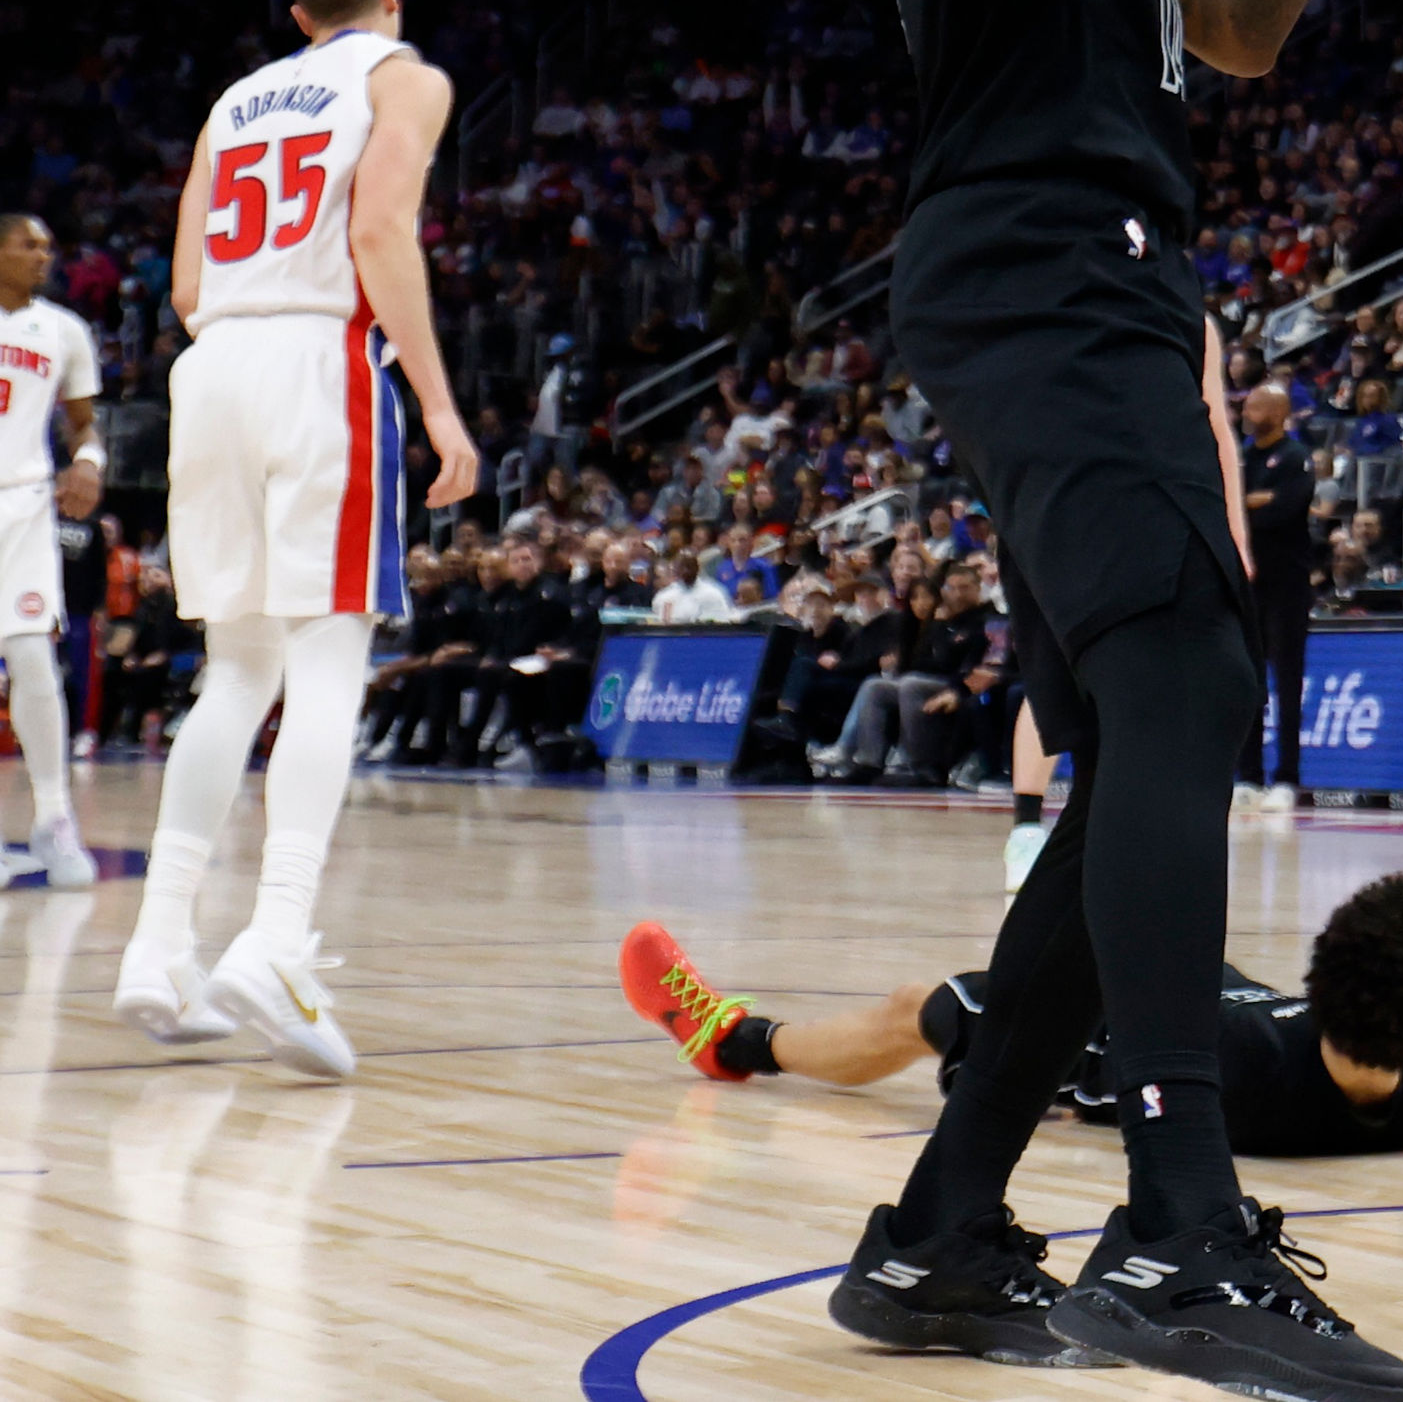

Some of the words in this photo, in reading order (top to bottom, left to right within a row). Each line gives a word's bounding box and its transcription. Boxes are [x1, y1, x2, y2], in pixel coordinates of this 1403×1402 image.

[229, 85, 339, 131] ROBINSON
[204, 130, 333, 264] 55
[624, 674, 694, 723] Globe
[695, 679, 743, 724] Life
